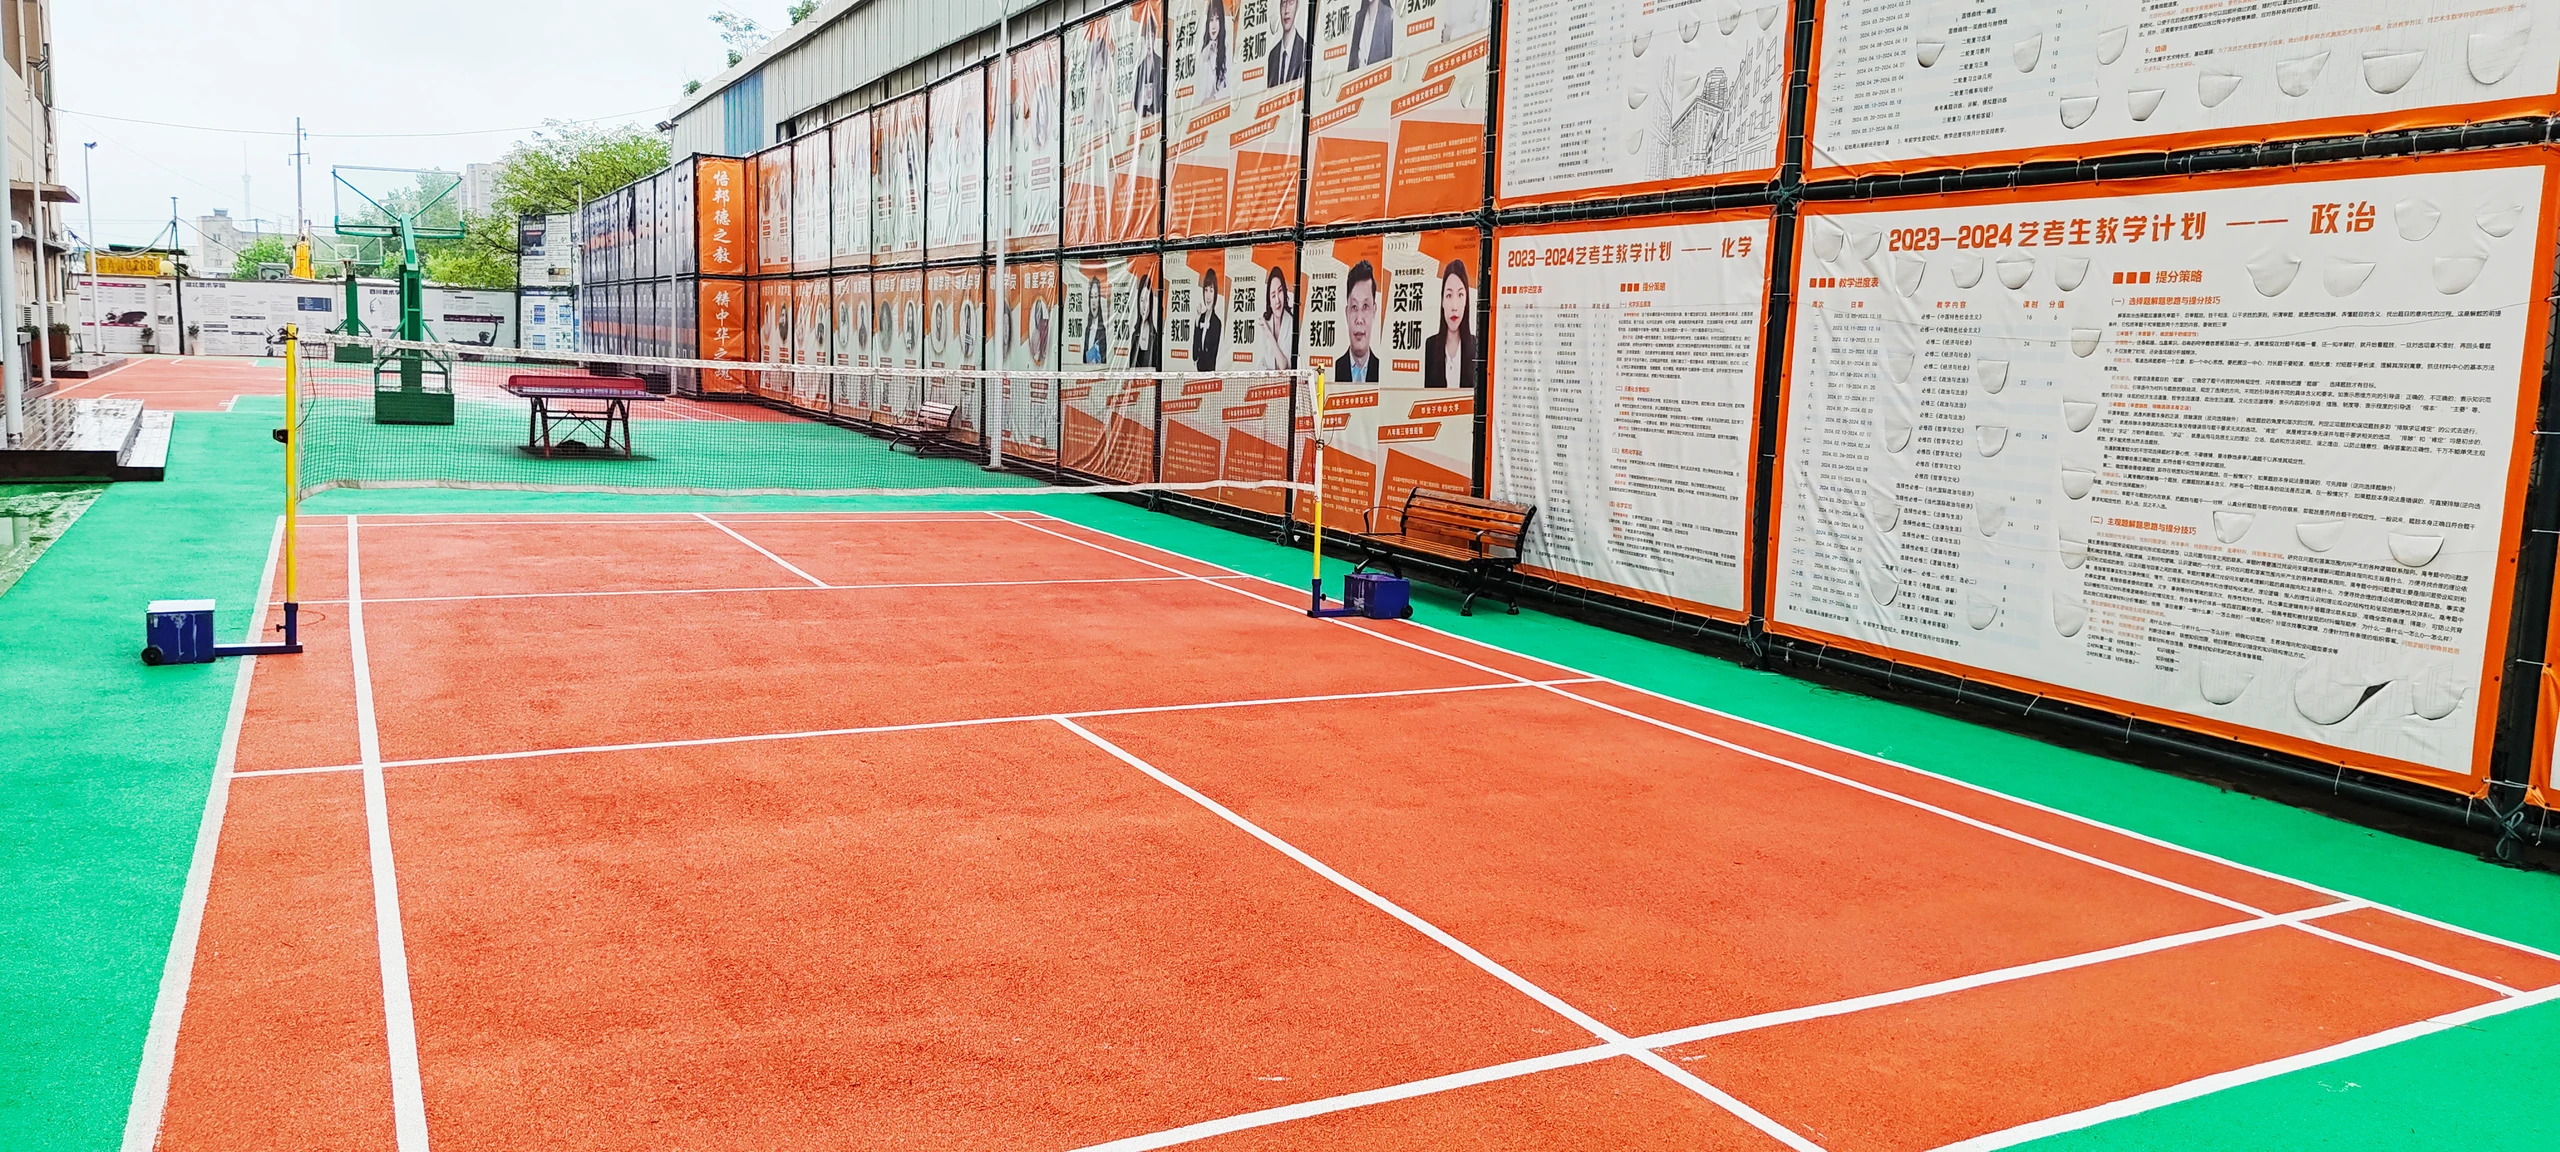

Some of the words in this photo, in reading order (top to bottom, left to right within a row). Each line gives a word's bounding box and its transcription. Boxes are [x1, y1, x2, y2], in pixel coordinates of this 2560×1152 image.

[1243, 0, 1268, 30] 资深
[1324, 6, 1352, 42] 教师
[1176, 20, 1196, 52] 资深
[1242, 31, 1267, 63] 教师
[1174, 54, 1196, 82] 教师
[1433, 45, 1484, 73] 毕业于华中师范大学
[2309, 200, 2376, 234] 政治
[1721, 236, 1752, 258] 化学
[1838, 277, 1879, 288] 教学进度表
[2154, 269, 2203, 283] 提分策略
[1068, 292, 1083, 312] 资深
[1171, 289, 1191, 313] 资深
[1233, 288, 1256, 313] 资深
[1310, 285, 1337, 313] 资深
[1394, 282, 1424, 313] 资深
[1811, 300, 1824, 308] 周次
[1850, 300, 1863, 308] 日期
[1936, 300, 1966, 308] 教学内容
[2022, 300, 2038, 308] 课时
[2048, 300, 2065, 308] 分值
[1068, 318, 1083, 338] 教师
[1171, 318, 1190, 342] 教师
[1233, 320, 1255, 344] 教师
[1309, 320, 1336, 348] 教师
[1392, 320, 1422, 350] 教师
[1421, 403, 1460, 415] 毕业于中山大学
